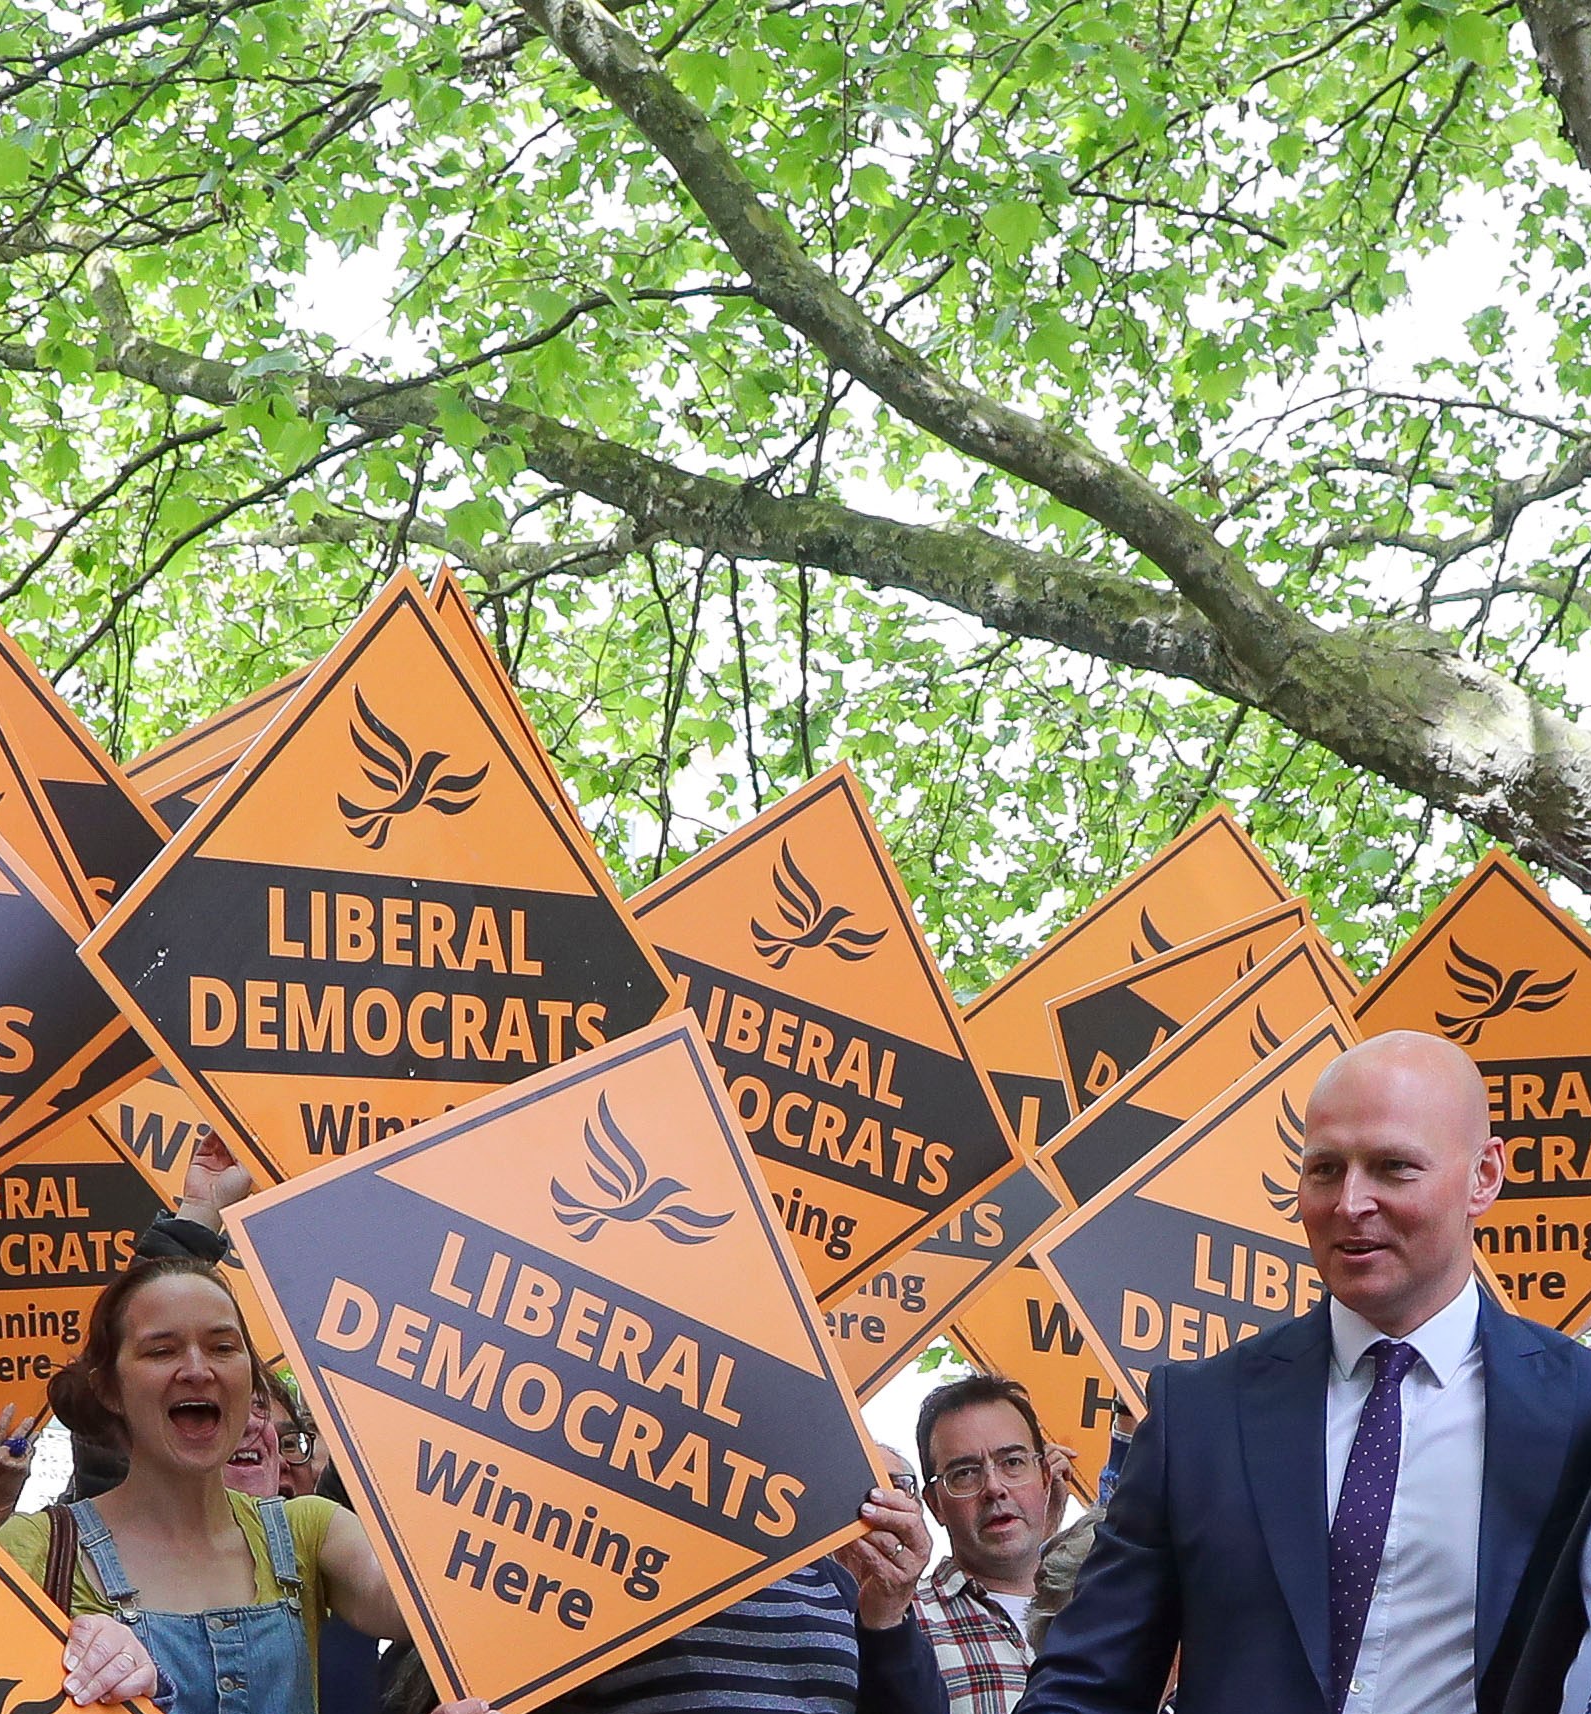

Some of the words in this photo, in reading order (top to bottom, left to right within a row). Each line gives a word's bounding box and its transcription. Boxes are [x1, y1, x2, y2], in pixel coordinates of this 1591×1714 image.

[267, 886, 544, 977] LIBERAL
[189, 975, 608, 1064] DEMOCRATS
[716, 1064, 954, 1197] OCRATS
[1193, 1233, 1323, 1319] LIBE
[1496, 1270, 1566, 1301] ere
[429, 1230, 742, 1428] LIBERAL
[315, 1276, 806, 1538] DEMOCRATS
[414, 1437, 671, 1602] Winning
[443, 1529, 595, 1632] Here
